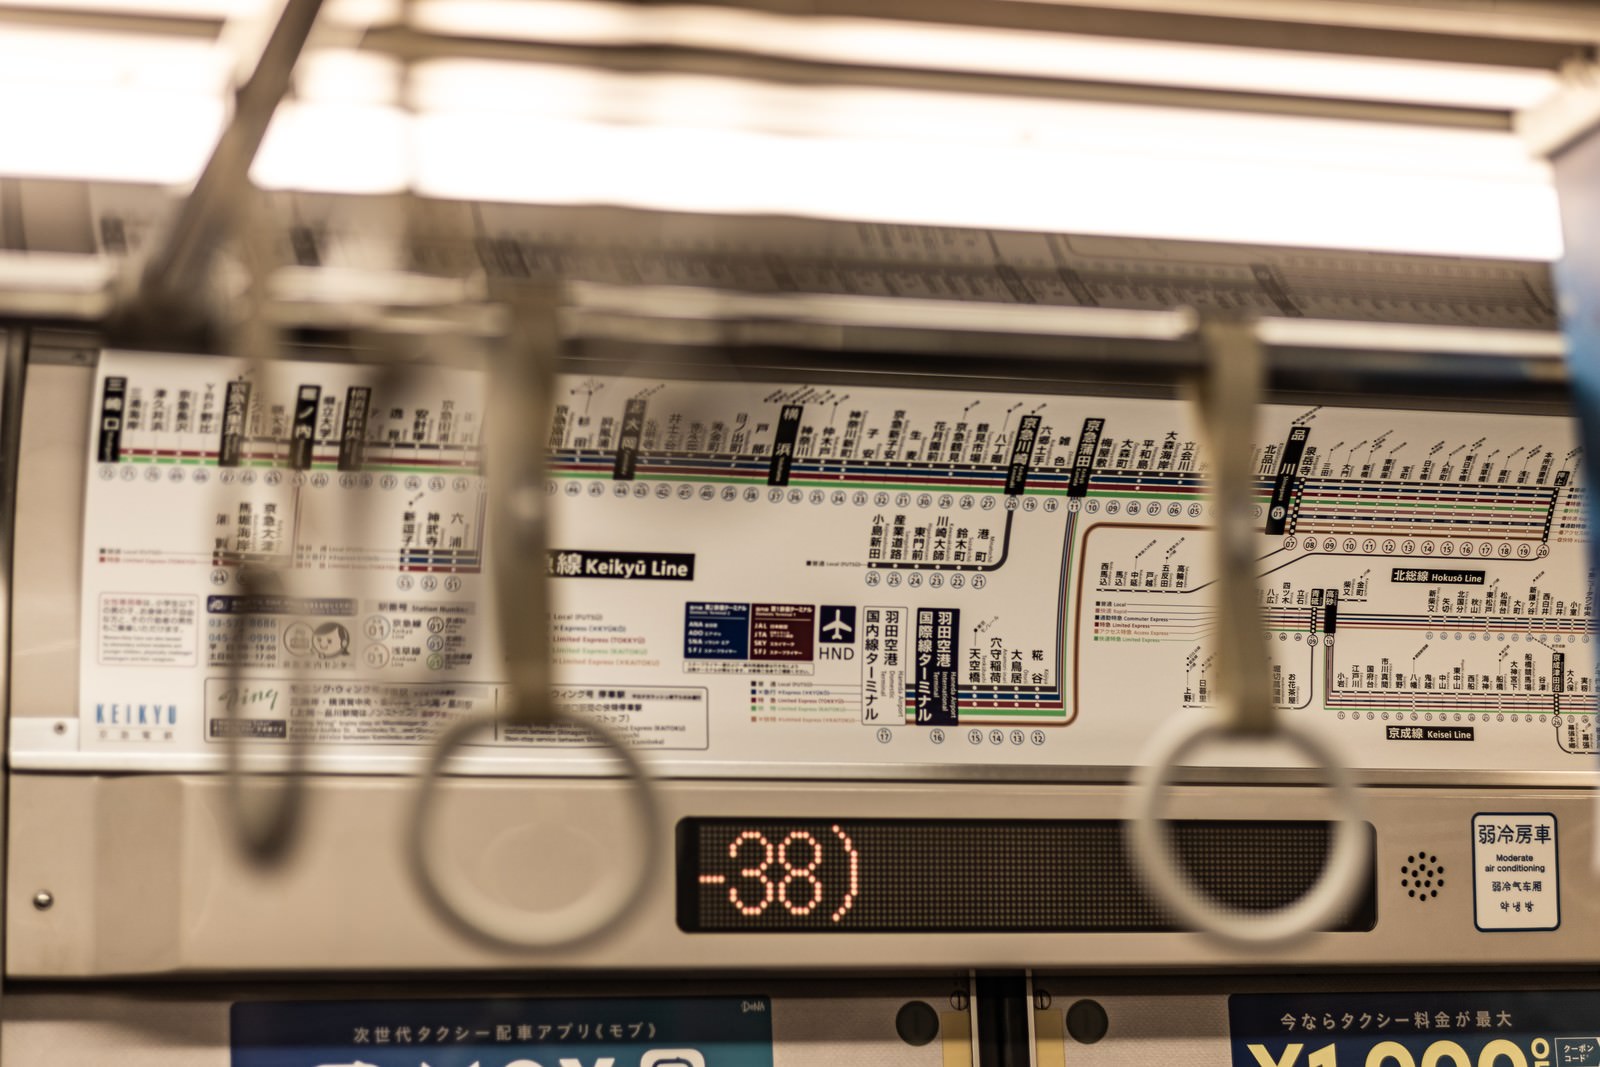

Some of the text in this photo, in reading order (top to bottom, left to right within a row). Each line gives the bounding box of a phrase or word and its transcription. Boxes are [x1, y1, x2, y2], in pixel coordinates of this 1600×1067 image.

[774, 408, 801, 454] 横浜
[841, 412, 861, 458] 神奈川新町
[884, 410, 905, 459] 京急新子安
[928, 422, 946, 461] 花月園前
[1013, 416, 1037, 465] 京急川崎
[863, 429, 878, 459] 子安
[907, 431, 921, 460] 生麦
[947, 423, 967, 462] 京急鶴見
[970, 424, 989, 463] 鶴見市場
[991, 434, 1007, 463] 八丁畷
[1033, 426, 1053, 465] 六郷土手
[1054, 437, 1070, 465] 雑色
[1076, 421, 1100, 466] 京急蒲田
[1095, 439, 1113, 467] 梅屋敷
[1116, 439, 1132, 468] 大森町
[1157, 432, 1178, 469] 大森海岸
[1281, 430, 1306, 475] 品川
[1137, 440, 1153, 469] 平和島
[1178, 442, 1195, 471] 立会川
[1259, 444, 1277, 474] 北品川
[1300, 446, 1317, 475] 泉岳寺
[869, 514, 884, 559] 小島新田
[890, 515, 906, 560] 産業道路
[912, 527, 926, 560] 東門前
[933, 516, 949, 561] 川崎大師
[954, 528, 968, 561] 鈴木町
[975, 529, 989, 563] 港町
[586, 557, 646, 578] Keikyū
[651, 562, 688, 576] Line
[1099, 563, 1109, 586] 西馬込
[1115, 571, 1123, 586] 馬込
[1161, 565, 1170, 587] 五反田
[1394, 570, 1482, 583] 北総線 Hokusō Line
[890, 576, 899, 584] 25
[911, 577, 920, 585] 24
[953, 578, 962, 586] 22
[974, 578, 983, 586] 21
[1130, 572, 1138, 586] 中延
[1145, 572, 1154, 587] 戸越
[1356, 581, 1364, 596] 金町
[1267, 589, 1274, 604] 八広
[1282, 582, 1291, 604] 四ツ木
[1297, 590, 1304, 605] 立石
[1456, 591, 1465, 613] 北国分
[1485, 592, 1493, 613] 東松戸
[1499, 592, 1508, 614] 松飛台
[1542, 593, 1550, 615] 西白井
[1442, 598, 1450, 613] 矢切
[1471, 599, 1479, 613] 秋山
[1513, 600, 1521, 614] 大町
[1556, 601, 1563, 615] 白井
[1570, 601, 1578, 616] 小室
[884, 611, 899, 666] 羽田空港
[936, 612, 952, 668] 羽田空港
[819, 648, 854, 660] HND
[990, 638, 1002, 683] 穴守稲荷
[865, 611, 880, 721] 国内線ターミナル
[917, 612, 933, 722] 国際線ターミナル
[969, 649, 981, 682] 天空橋
[1011, 650, 1022, 683] 大鳥居
[1032, 650, 1044, 683] 糀谷
[1288, 674, 1296, 704] お花茶屋
[1337, 673, 1345, 688] 小岩
[1439, 675, 1446, 689] 中山
[1453, 667, 1461, 689] 東中山
[1468, 675, 1475, 689] 西船
[1538, 677, 1546, 691] 谷津
[1566, 669, 1574, 691] 大久保
[96, 704, 176, 725] KEIKYU
[1389, 728, 1471, 739] 京成線 Keisei Line
[1478, 824, 1551, 844] 弱冷房車
[1497, 865, 1545, 873] conditioning
[1492, 881, 1541, 892] 弱冷气车厢
[1281, 1011, 1512, 1030] 今ならタクシー料金が最大
[1564, 1045, 1593, 1053] クーポン
[1565, 1054, 1585, 1062] コード
